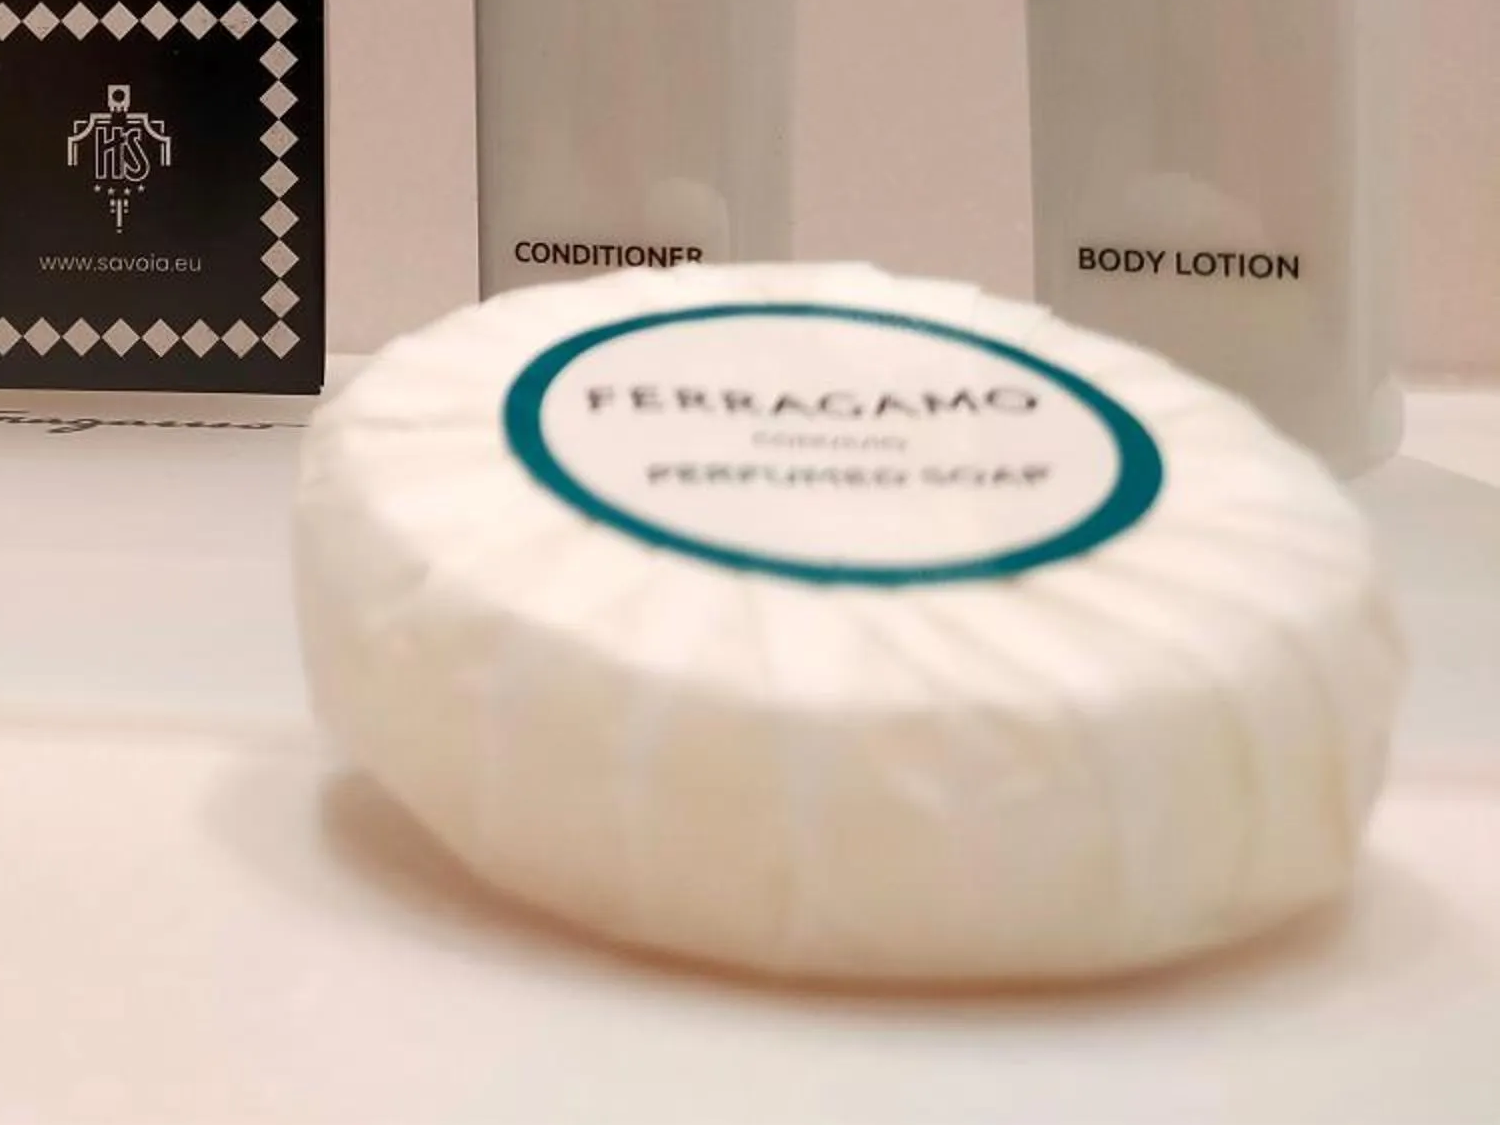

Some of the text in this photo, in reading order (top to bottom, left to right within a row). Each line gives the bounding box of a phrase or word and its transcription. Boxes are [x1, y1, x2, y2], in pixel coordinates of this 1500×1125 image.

[39, 254, 201, 272] www.savoia.eu
[1078, 247, 1299, 280] BODY LOTION
[586, 385, 1038, 418] FERRAGAMO
